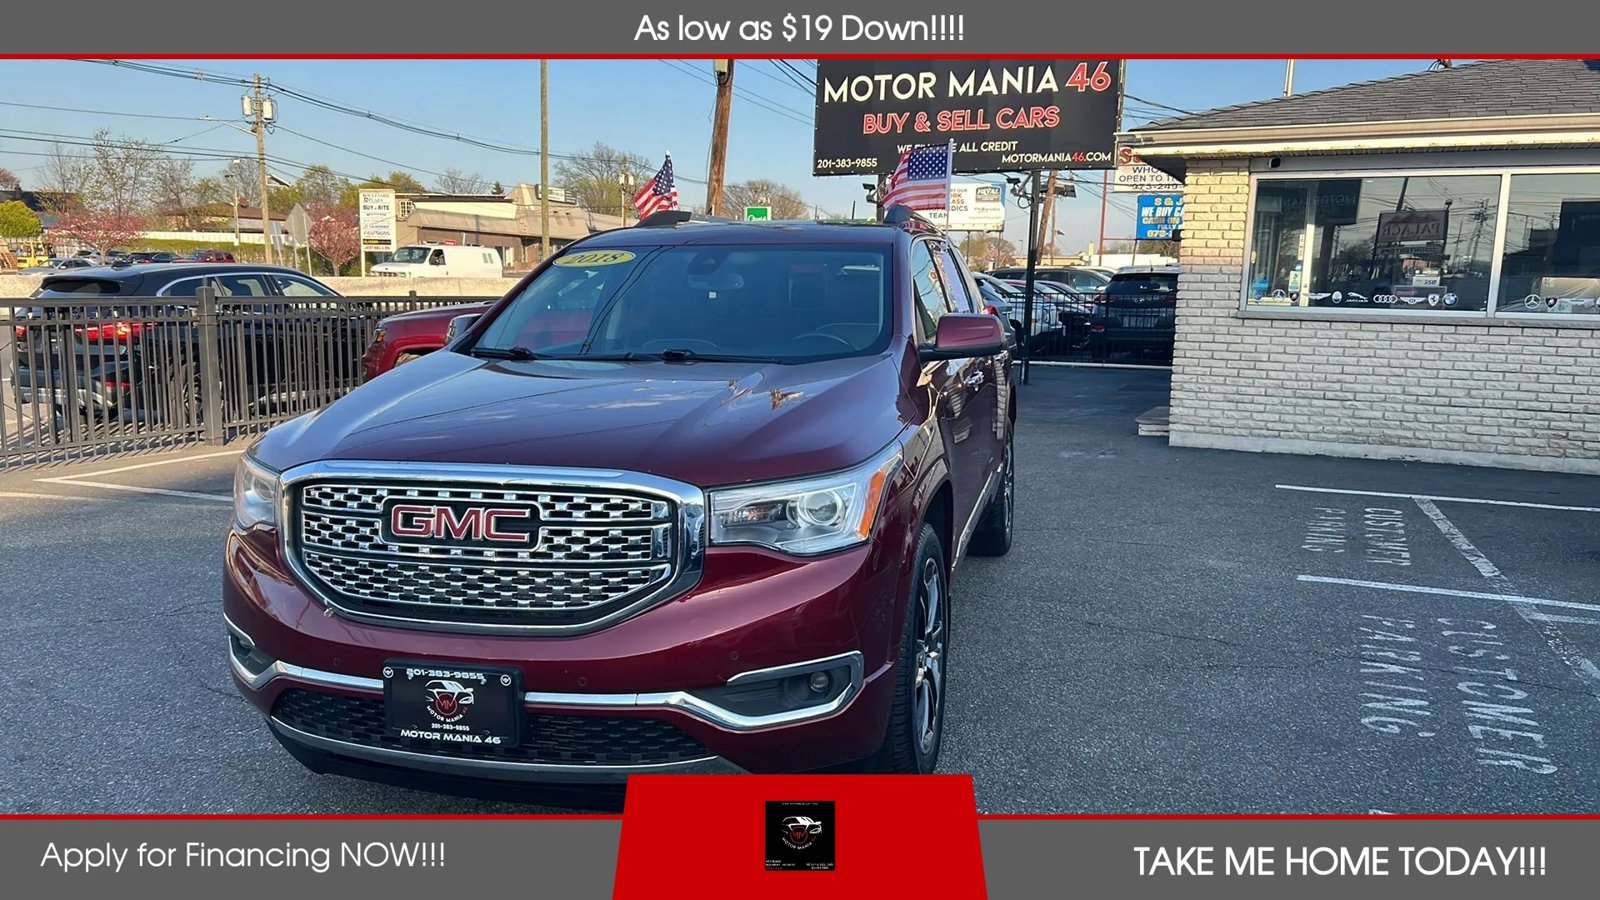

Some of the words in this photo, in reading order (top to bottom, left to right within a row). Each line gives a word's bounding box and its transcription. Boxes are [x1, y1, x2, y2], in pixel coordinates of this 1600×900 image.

[824, 71, 937, 103] MOTOR
[948, 65, 1059, 98] MANIA
[1065, 61, 1112, 92] 46
[863, 111, 910, 134] BUY
[914, 111, 931, 132] &
[937, 109, 991, 132] SELL
[996, 105, 1061, 129] CARS
[959, 142, 978, 153] ALL
[981, 141, 1018, 152] CREDIT
[817, 157, 878, 169] 201-383-9855
[1002, 151, 1112, 163] MOTORMANIA46.COM
[1119, 174, 1147, 182] OPEN
[1150, 174, 1163, 182] TO
[1141, 206, 1156, 217] WE
[1155, 206, 1174, 217] BUY
[563, 252, 625, 265] 2018
[391, 504, 530, 542] GMC
[406, 668, 486, 681] 201-383-9855
[1358, 614, 1436, 738] PARKING
[1437, 616, 1558, 775] CUSTOMER
[400, 729, 441, 741] MOTOR
[443, 733, 482, 744] MANIA
[484, 737, 501, 745] 46
